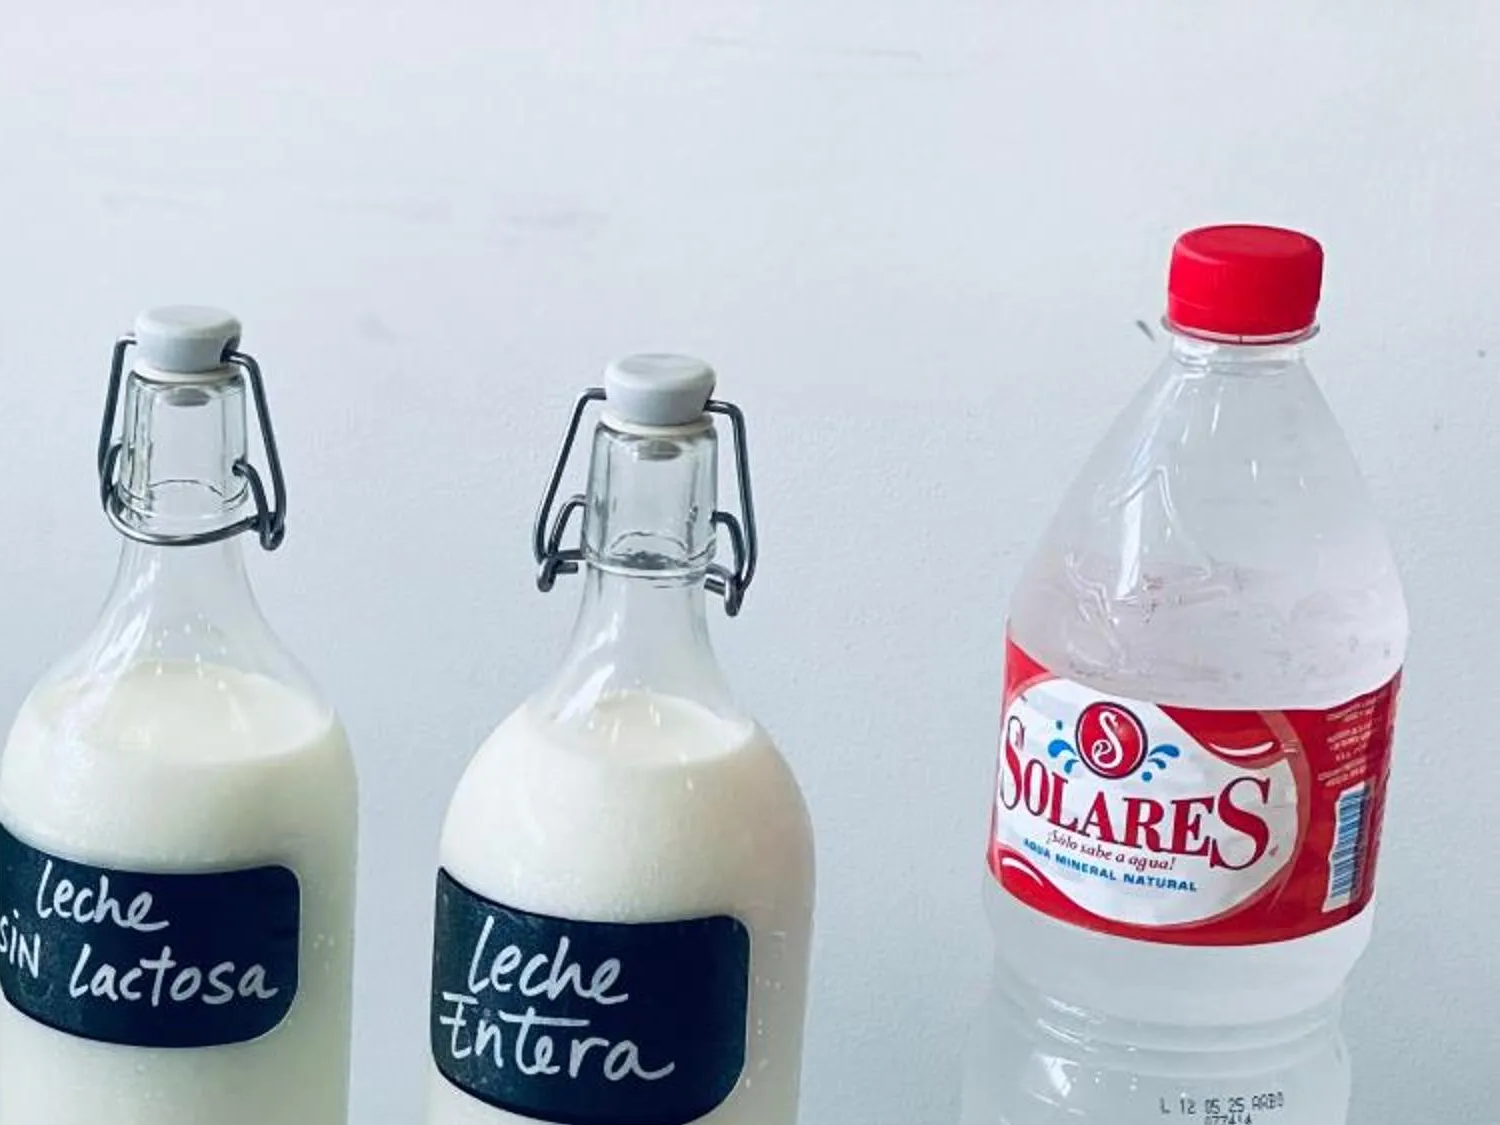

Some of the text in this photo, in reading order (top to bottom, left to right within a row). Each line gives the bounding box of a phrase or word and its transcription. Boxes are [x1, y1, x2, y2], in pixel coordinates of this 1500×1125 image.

[1054, 853, 1116, 882] MINERAL
[1123, 871, 1197, 892] NATURAL
[1129, 852, 1175, 872] agua!
[37, 860, 170, 932] Leche
[468, 915, 629, 1004] Leche
[1159, 1097, 1171, 1114] L
